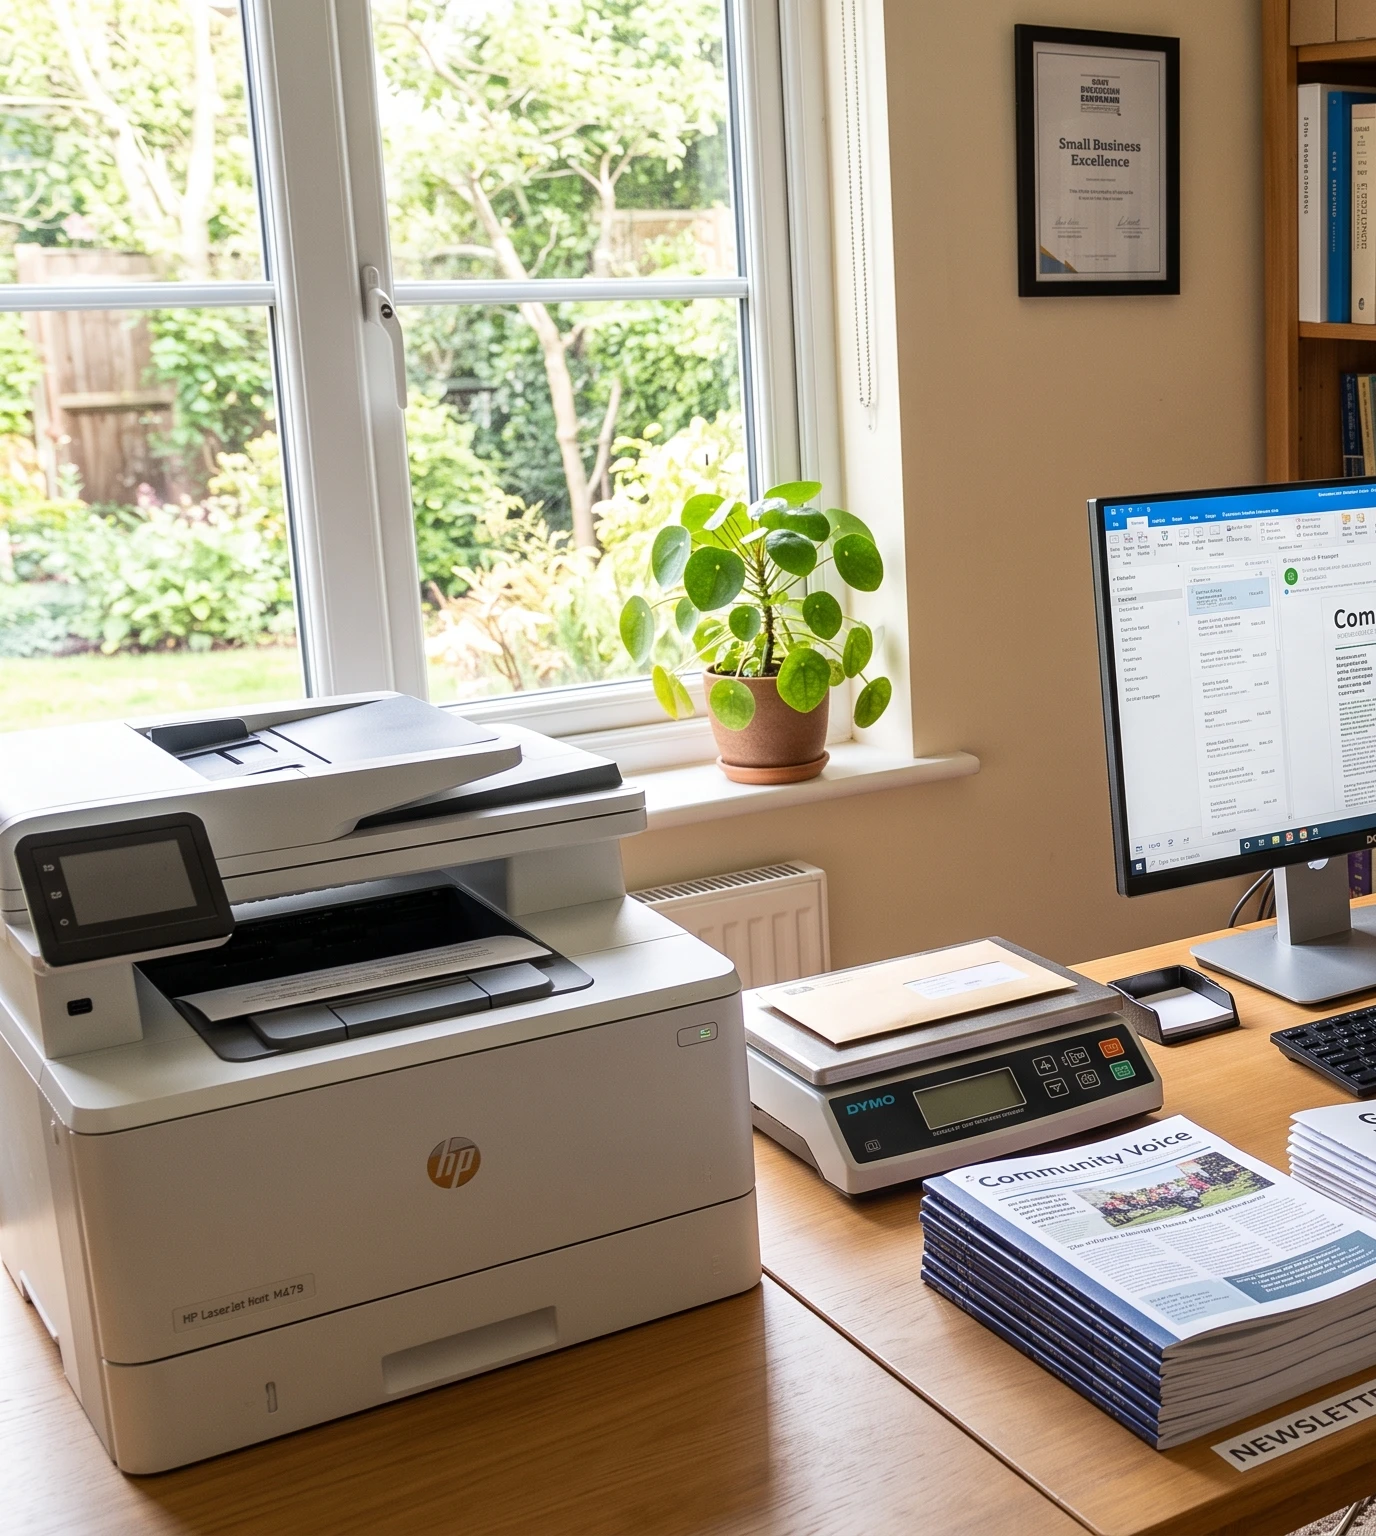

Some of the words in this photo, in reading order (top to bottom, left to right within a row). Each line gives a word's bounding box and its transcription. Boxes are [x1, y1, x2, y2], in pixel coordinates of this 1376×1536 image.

[1059, 137, 1091, 151] Small
[1093, 138, 1141, 153] Business
[1071, 154, 1130, 168] Excellence
[847, 1095, 896, 1116] DYMO
[431, 1137, 479, 1188] hp
[977, 1151, 1123, 1190] Community
[1128, 1129, 1193, 1156] Voice
[183, 1312, 198, 1324] HP
